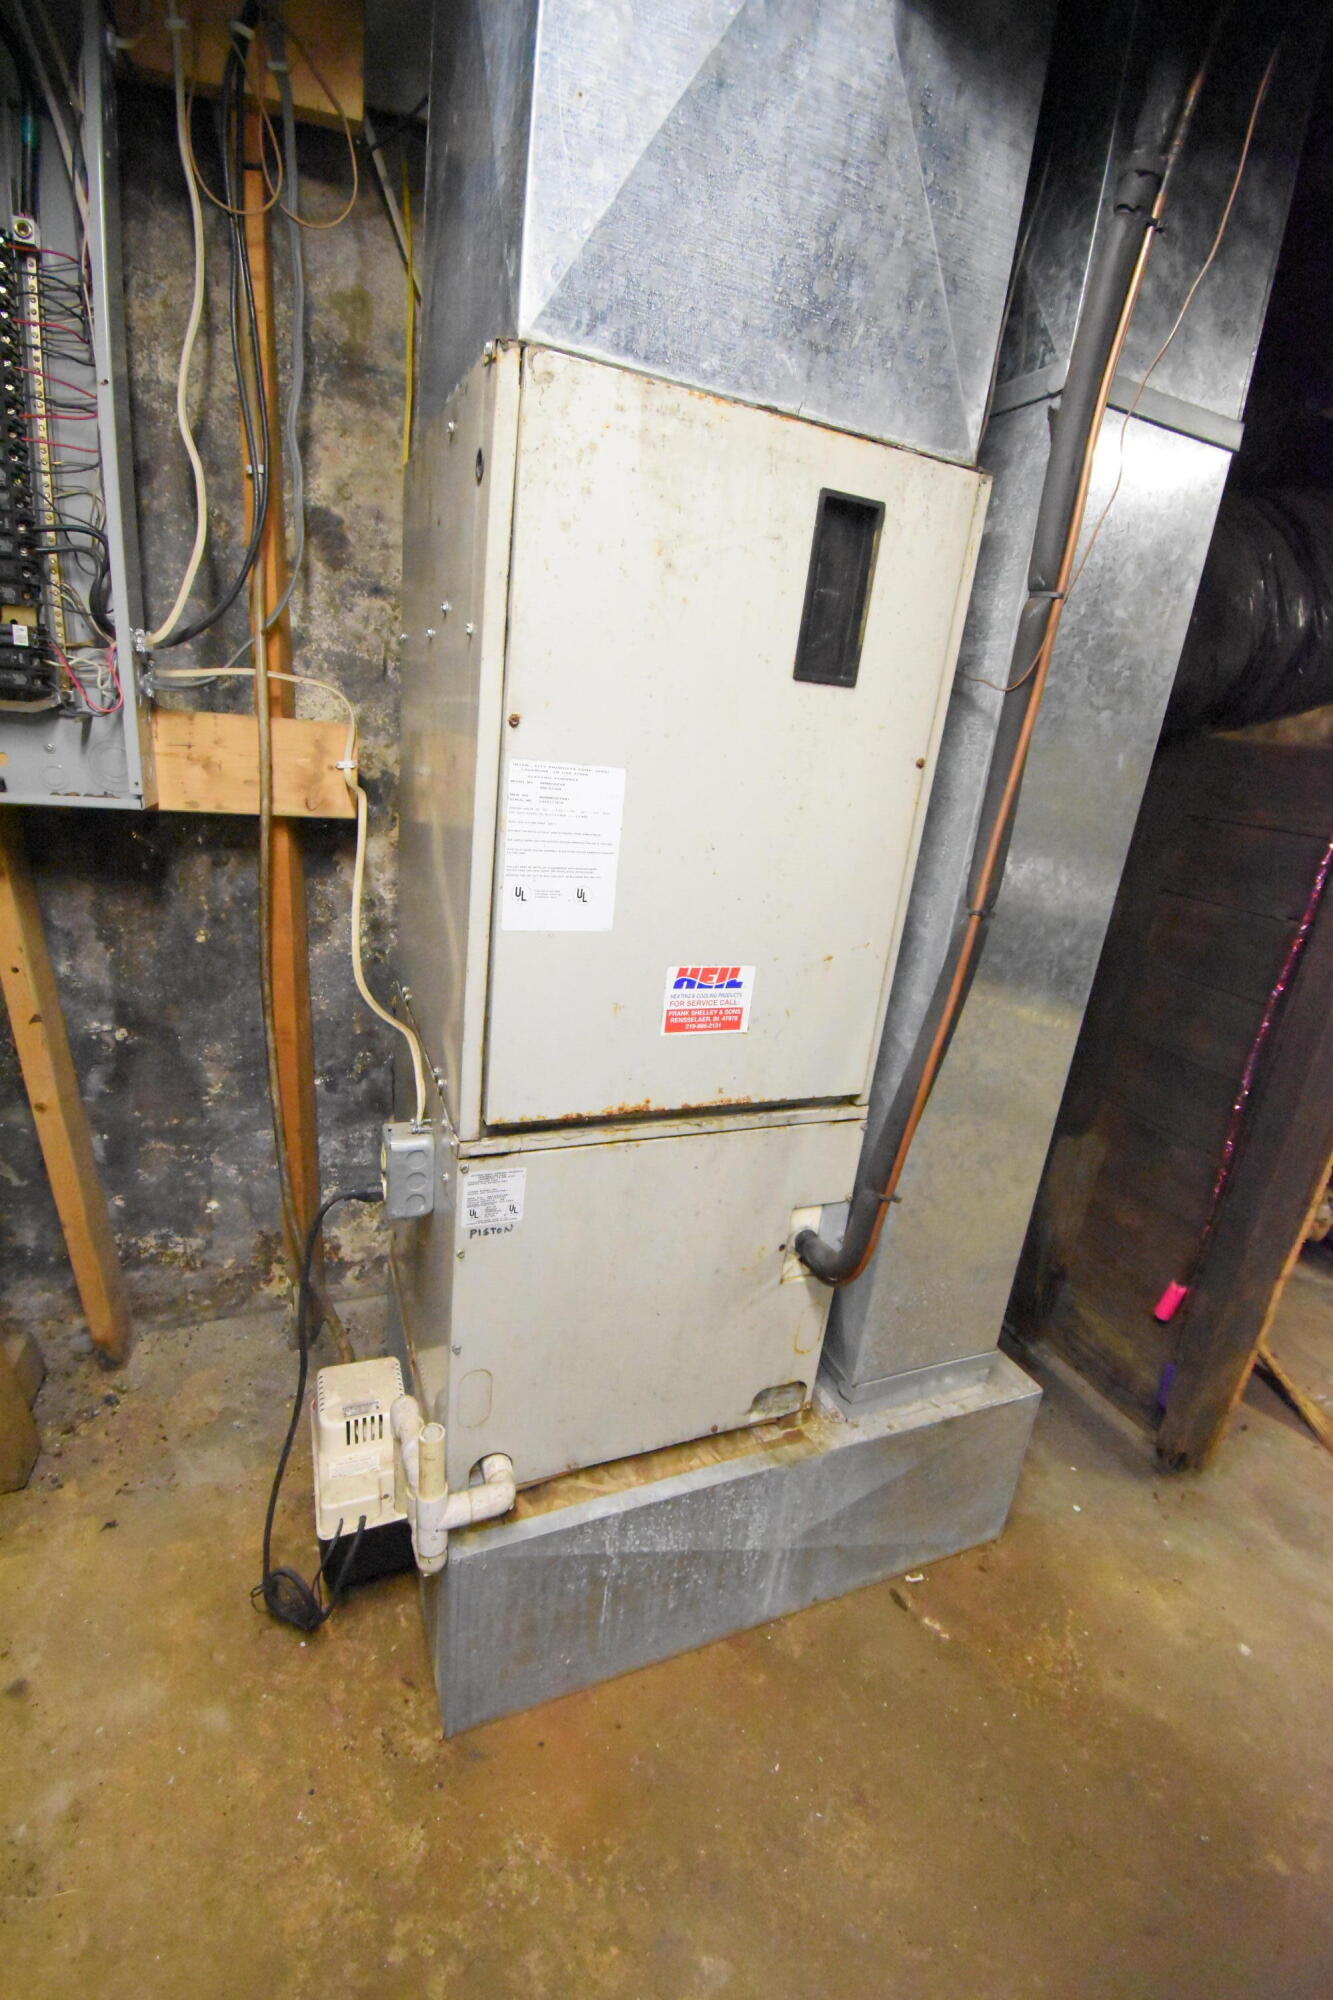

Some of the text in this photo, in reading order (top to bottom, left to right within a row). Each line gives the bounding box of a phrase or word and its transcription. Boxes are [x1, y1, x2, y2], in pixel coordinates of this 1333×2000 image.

[514, 886, 527, 902] UL
[576, 888, 588, 903] UL
[673, 967, 744, 989] HEIL
[687, 999, 718, 1007] SERVICE
[469, 1223, 514, 1239] PISTON
